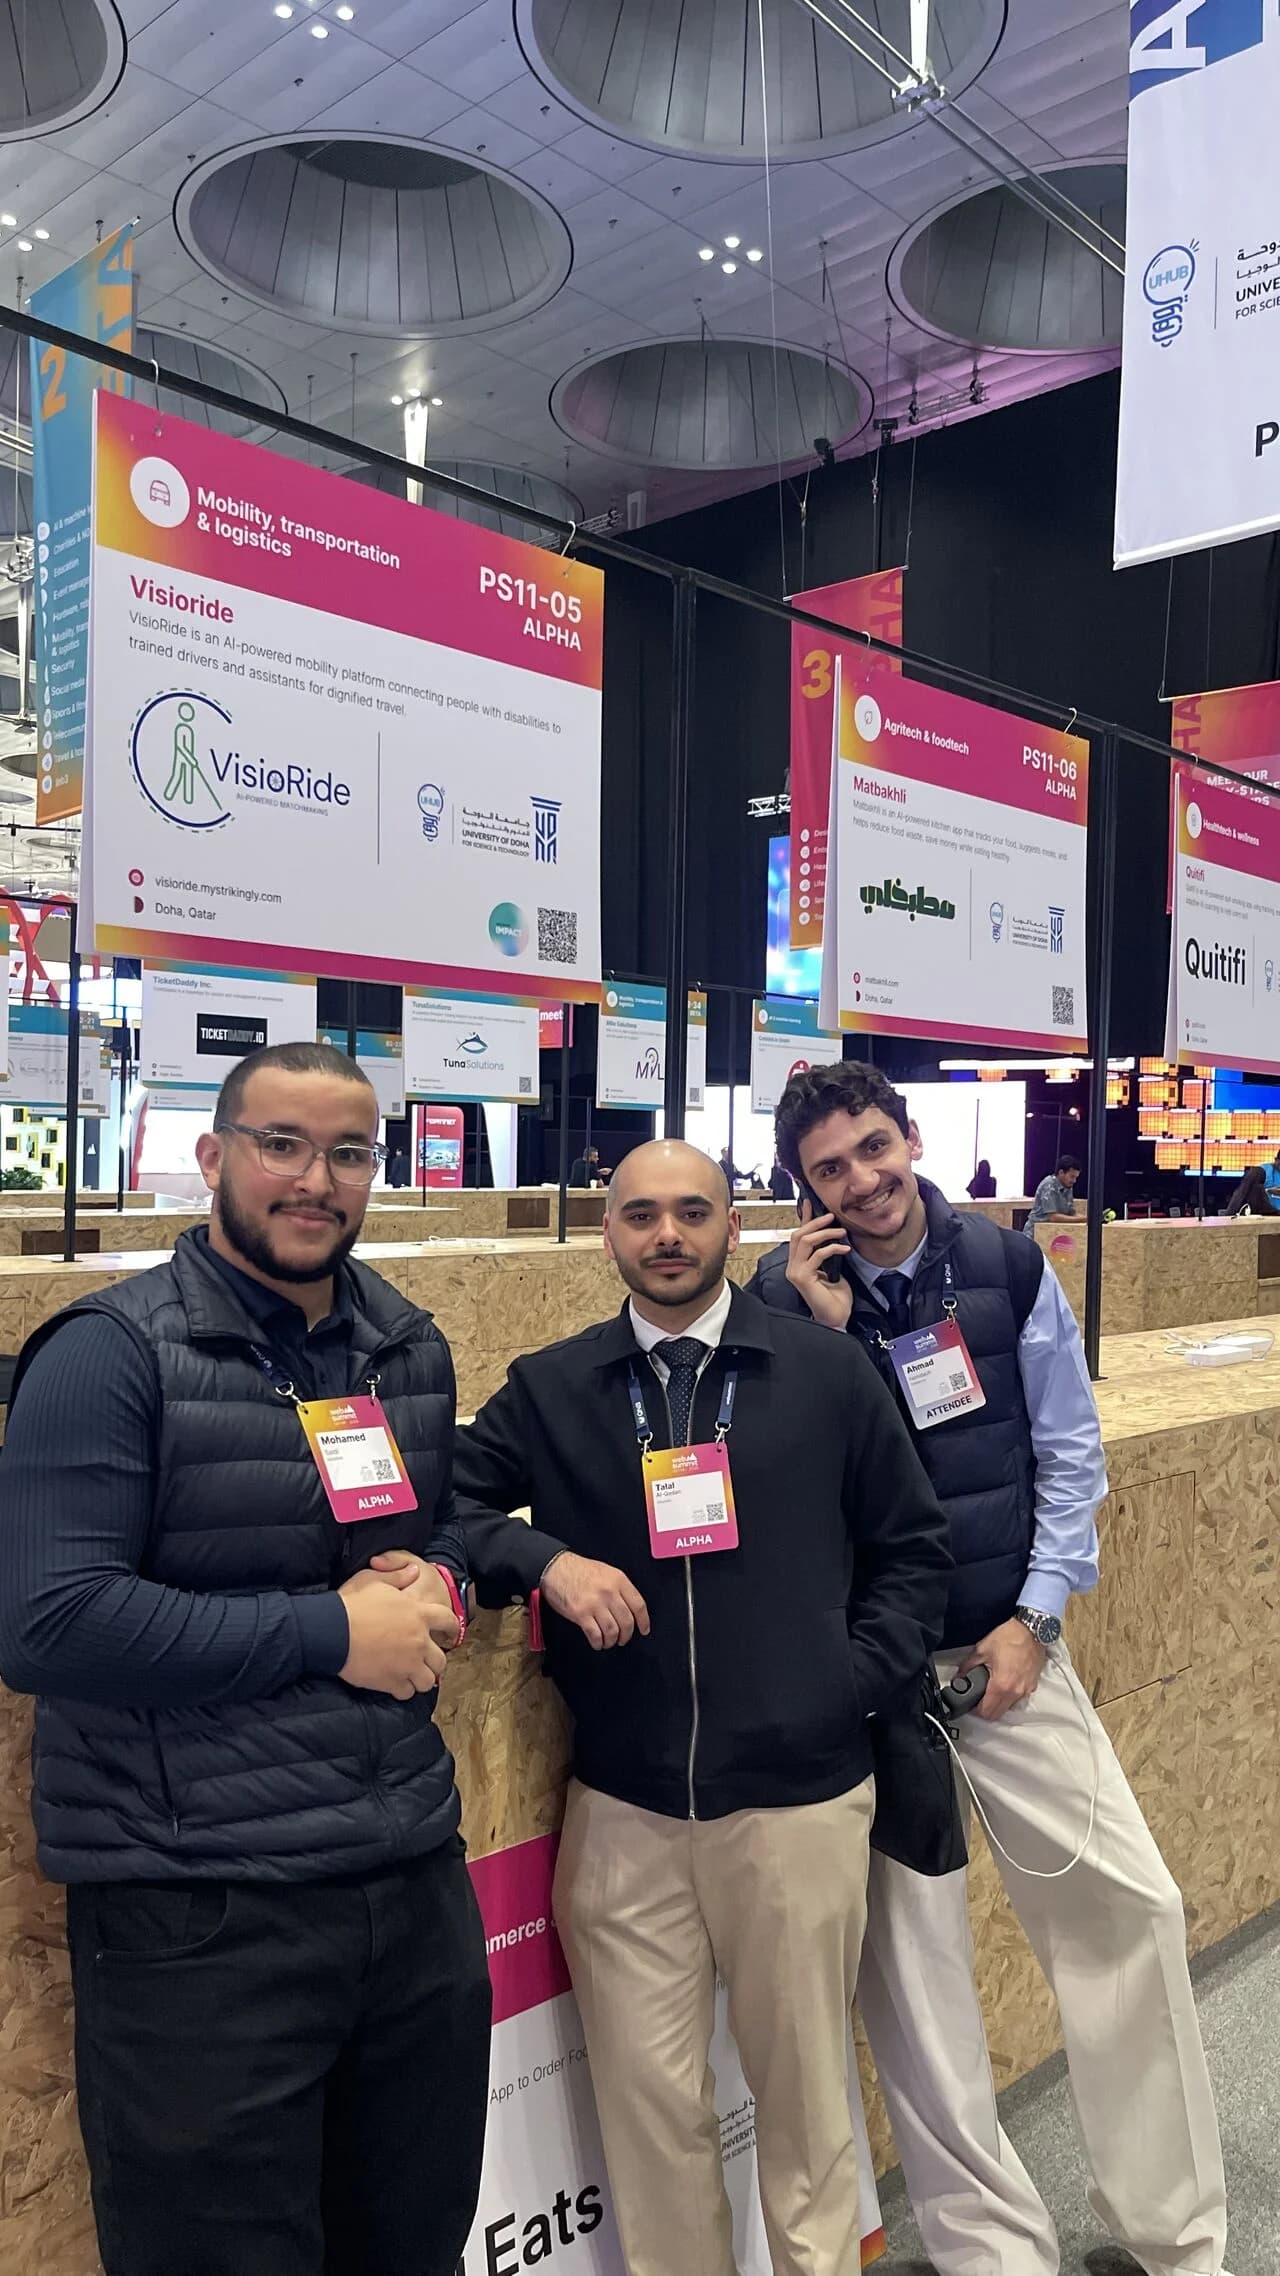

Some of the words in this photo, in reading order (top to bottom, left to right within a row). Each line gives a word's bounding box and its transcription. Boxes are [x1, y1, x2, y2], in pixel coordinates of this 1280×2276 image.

[1149, 265, 1189, 289] UHUB
[1236, 304, 1256, 320] FOR
[40, 346, 66, 419] 2
[197, 487, 275, 532] Mobility,
[280, 516, 400, 569] transportation
[197, 512, 210, 531] &
[215, 517, 291, 557] logistics
[54, 558, 79, 577] Education
[130, 575, 234, 623] Visioride
[480, 566, 582, 624] PS11-05
[523, 617, 581, 651] ALPHA
[51, 660, 75, 674] Security
[129, 636, 172, 658] trained
[177, 649, 219, 670] drivers
[223, 662, 245, 676] and
[249, 667, 305, 691] assistants
[309, 680, 324, 695] for
[327, 686, 372, 708] dignified
[376, 699, 406, 717] travel.
[130, 610, 187, 637] VisioRide
[191, 626, 200, 640] is
[205, 632, 219, 646] an
[224, 637, 291, 664] AI-powered
[295, 655, 338, 680] mobility
[341, 667, 385, 689] platform
[388, 680, 444, 706] connecting
[446, 696, 479, 714] people
[482, 704, 501, 719] with
[504, 709, 550, 732] disabilities
[552, 723, 561, 734] to
[802, 649, 832, 699] 3
[51, 682, 69, 696] Social
[884, 718, 922, 740] Agritech
[923, 728, 930, 743] &
[931, 731, 969, 755] foodtech
[1023, 746, 1077, 781] PS11-06
[210, 748, 350, 806] VisioRide
[853, 775, 906, 804] Matbakhli
[1045, 779, 1077, 800] ALPHA
[462, 830, 500, 844] UNIVERSITY
[500, 837, 510, 845] OF
[511, 838, 529, 848] DOHA
[473, 841, 492, 851] SCIENCE
[498, 847, 529, 857] TECHNOLOGY
[1233, 828, 1236, 839] &
[1237, 832, 1259, 846] wellness
[1185, 866, 1205, 883] Quitifi
[155, 876, 282, 903] visioride.mystrikingly.com
[155, 902, 185, 918] Doha,
[188, 907, 216, 920] Qatar
[495, 926, 522, 937] IMPACT
[1185, 938, 1246, 985] Quitifi
[153, 976, 198, 989] TicketDaddy
[907, 1359, 934, 1374] Ahmad
[926, 1394, 973, 1419] ATTENDEE
[321, 1433, 366, 1446] Mohamed
[655, 1482, 675, 1491] Talal
[358, 1494, 393, 1510] ALPHA
[676, 1534, 713, 1549] ALPHA
[490, 2083, 514, 2104] App
[518, 2075, 529, 2090] to
[533, 2055, 565, 2082] Order
[569, 2046, 588, 2064] Foo
[721, 2125, 755, 2152] UNIVERSIT
[485, 2185, 603, 2276] Eats
